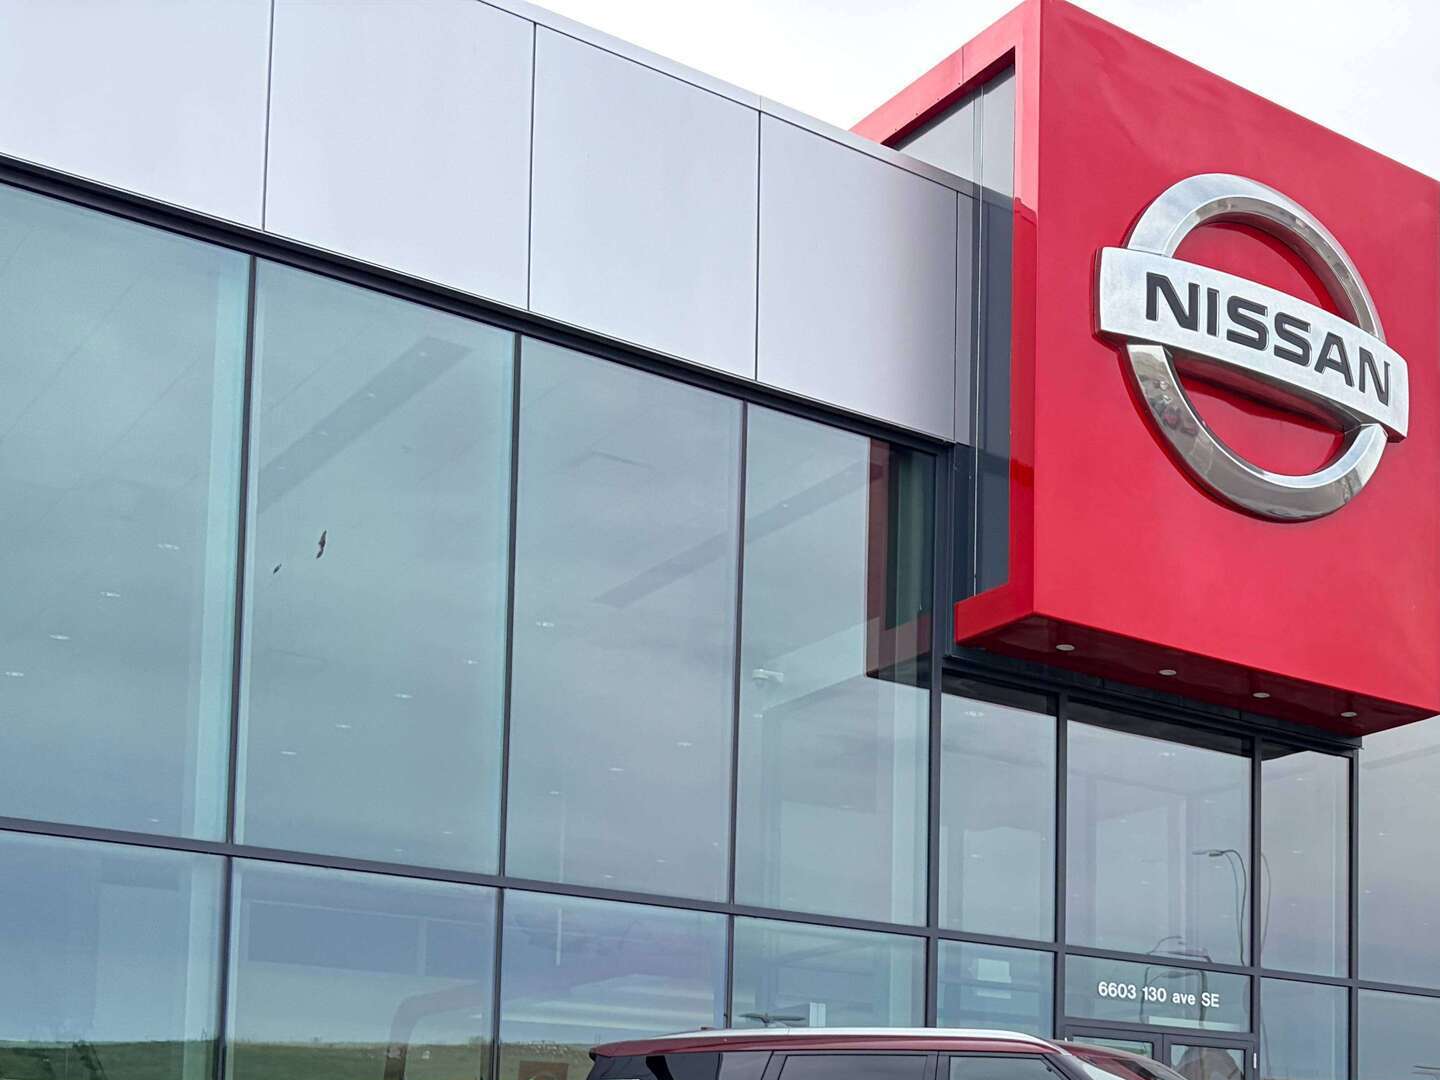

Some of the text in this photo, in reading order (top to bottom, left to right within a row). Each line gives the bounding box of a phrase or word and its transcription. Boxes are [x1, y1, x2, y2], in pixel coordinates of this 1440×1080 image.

[1145, 271, 1391, 407] NISSAN
[1098, 981, 1220, 1008] 6603 130 ave SE
